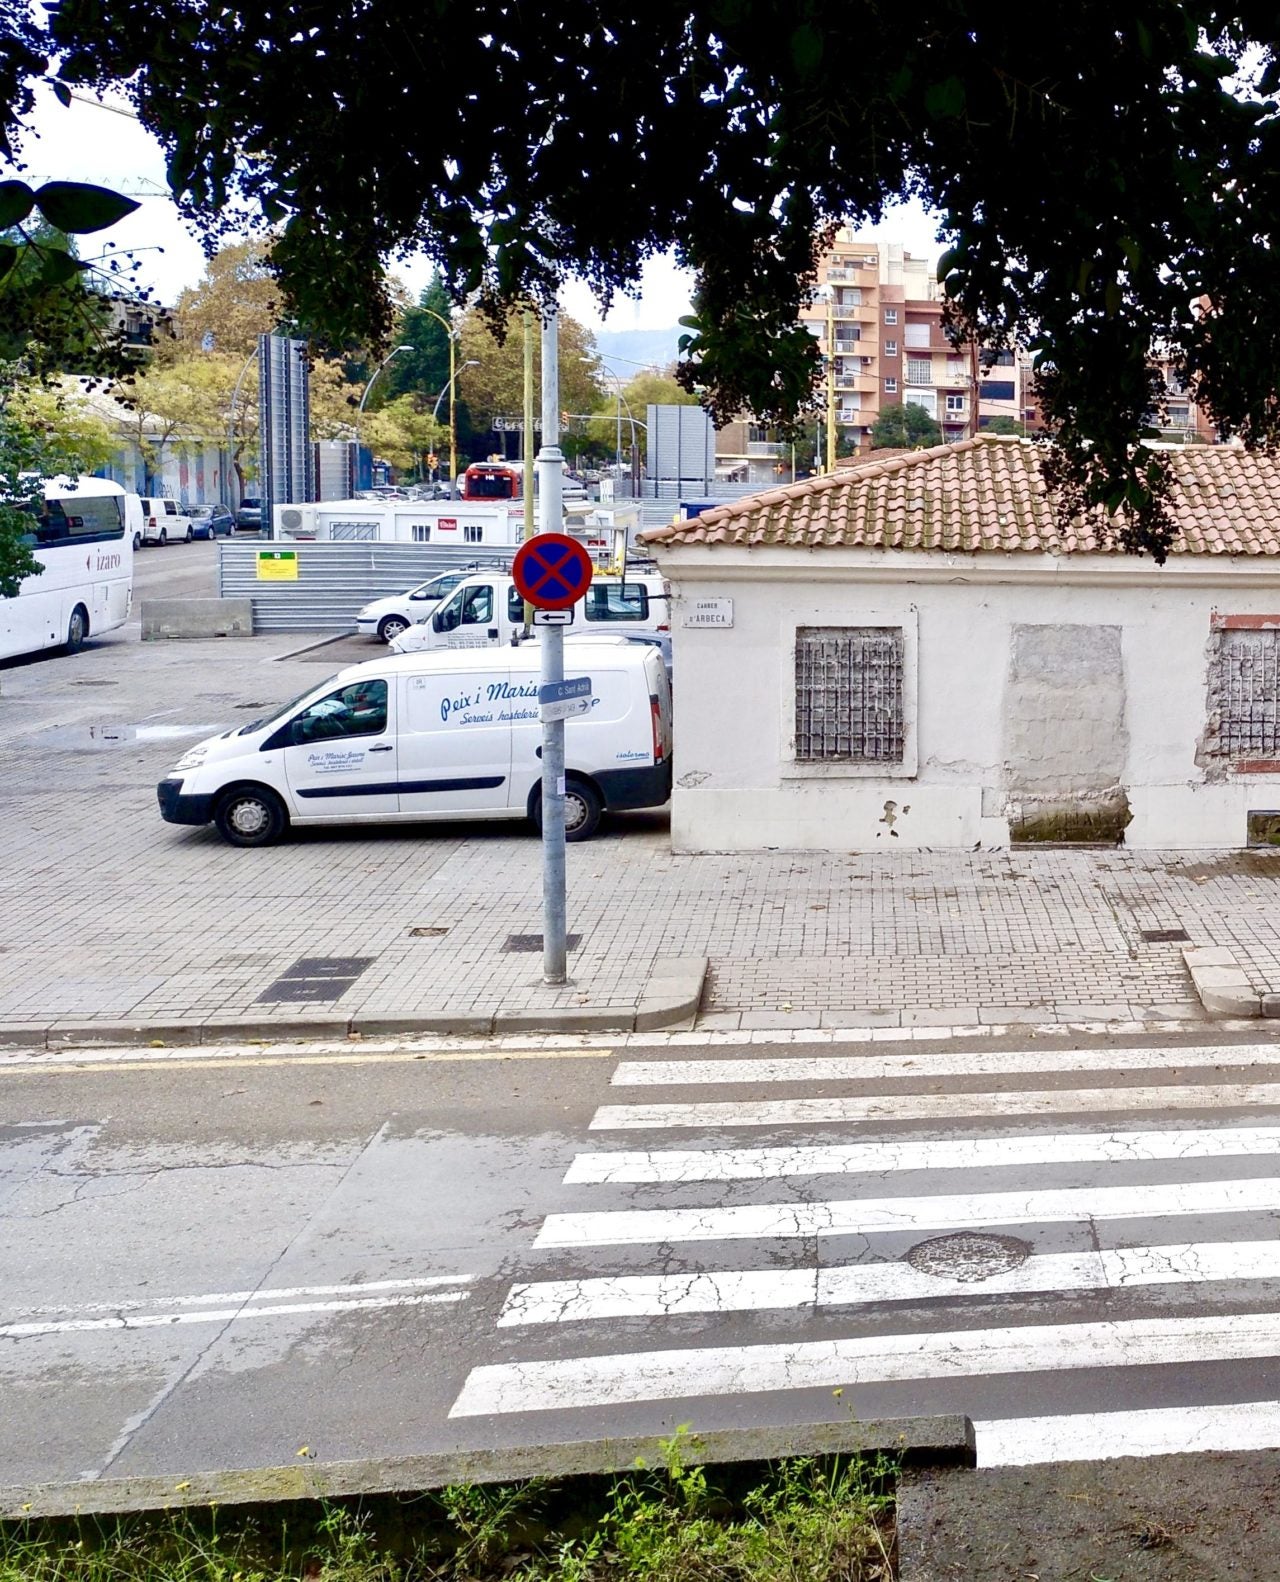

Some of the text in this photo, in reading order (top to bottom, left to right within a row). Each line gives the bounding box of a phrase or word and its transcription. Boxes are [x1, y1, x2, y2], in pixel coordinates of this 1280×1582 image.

[689, 614, 726, 623] D'ARBECA
[440, 680, 541, 722] Peix i Maris
